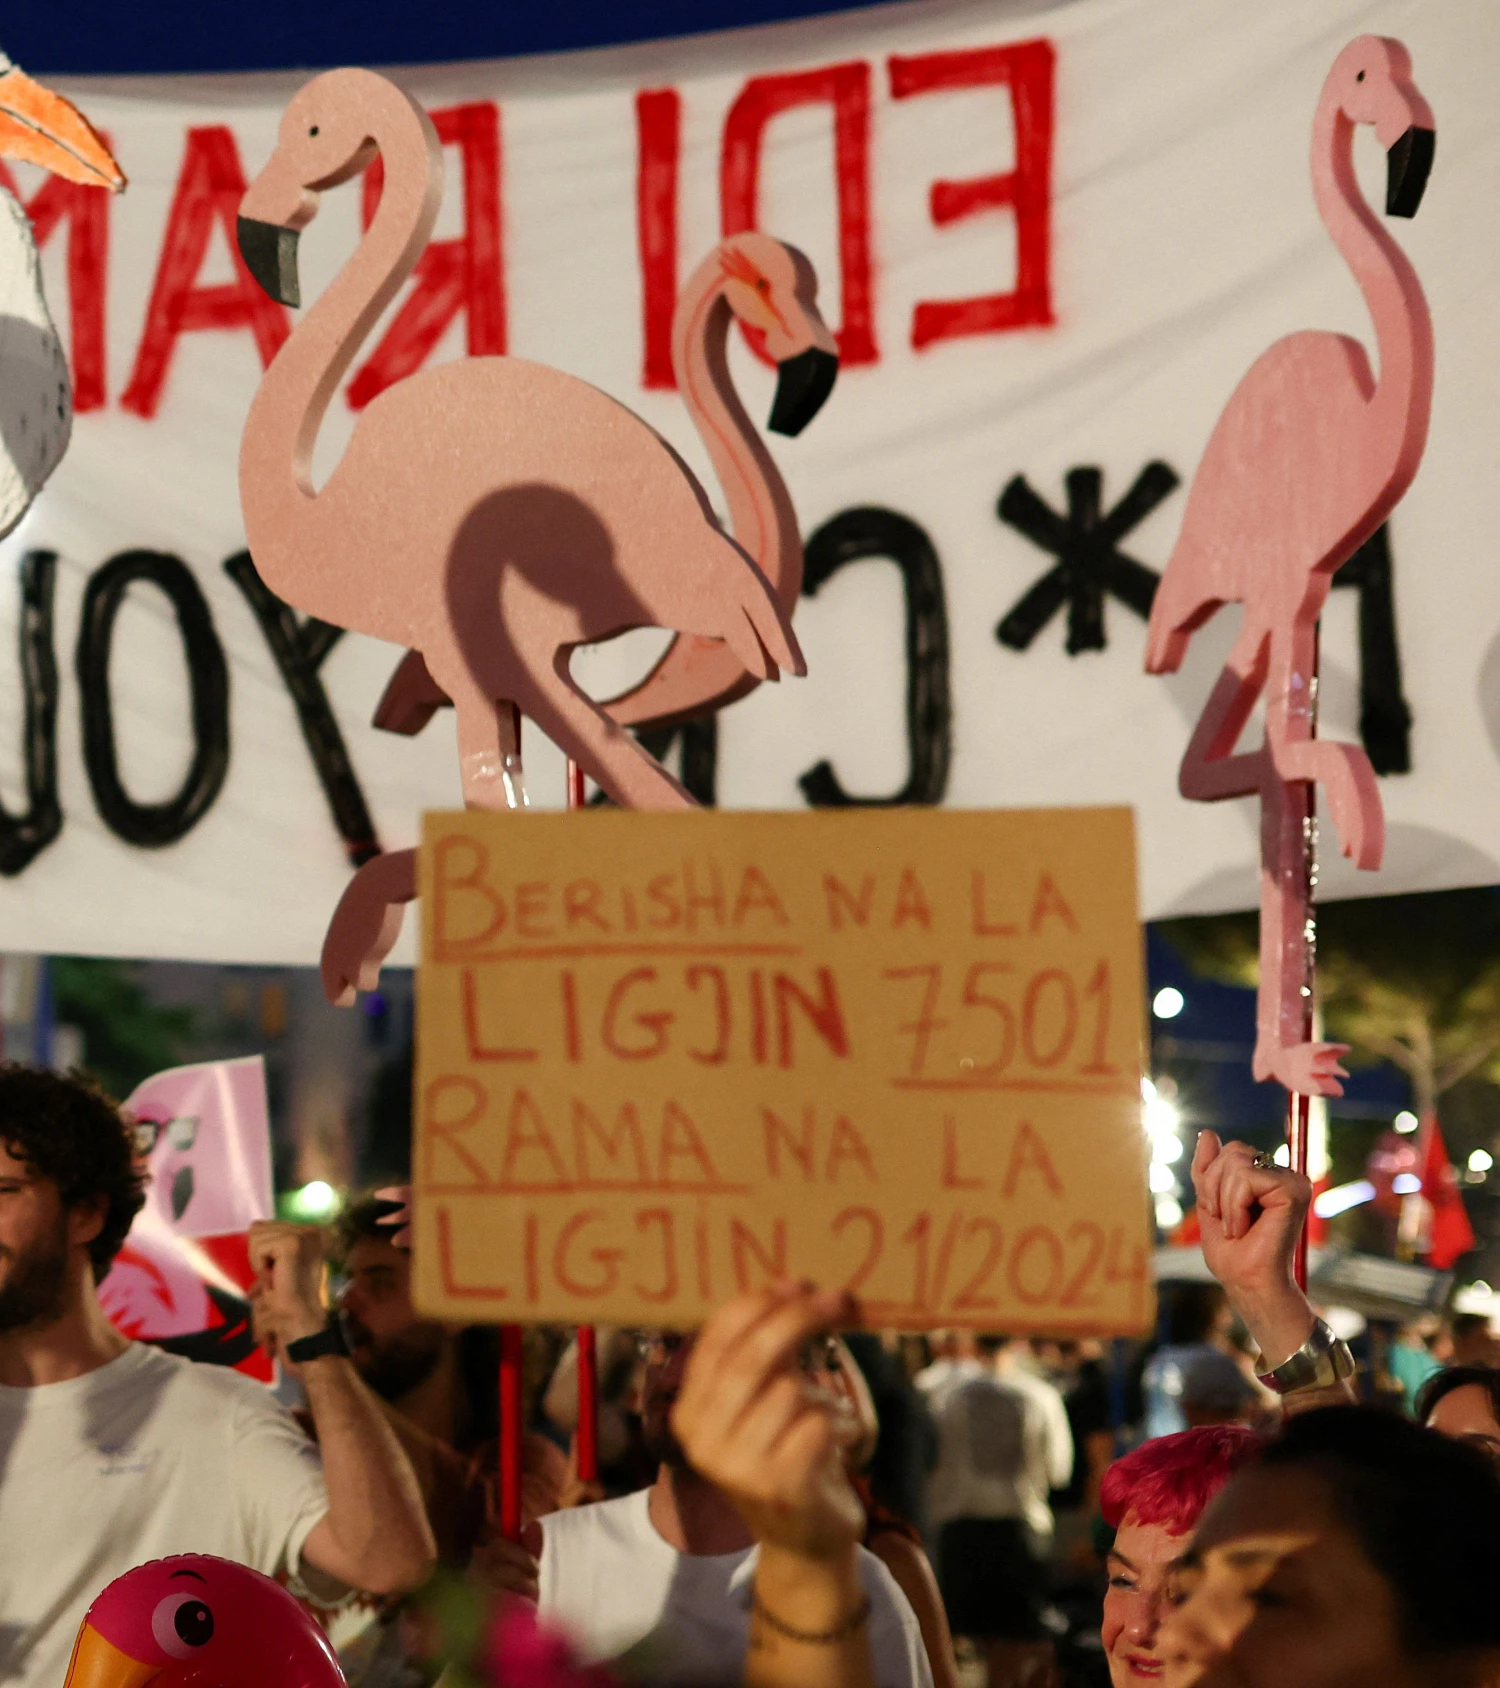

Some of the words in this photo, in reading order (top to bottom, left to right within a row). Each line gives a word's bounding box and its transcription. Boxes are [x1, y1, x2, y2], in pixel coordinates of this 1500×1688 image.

[432, 834, 789, 954] BERISHA
[823, 867, 932, 931] NA
[971, 869, 1080, 936] LA
[460, 963, 851, 1069] LIGJIN
[884, 958, 1120, 1078] 7501
[423, 1073, 724, 1186] RAMA
[760, 1102, 881, 1184] NA
[941, 1112, 1064, 1200] LA
[436, 1200, 789, 1304] LIGJIN
[830, 1205, 1147, 1322] 21/2024
